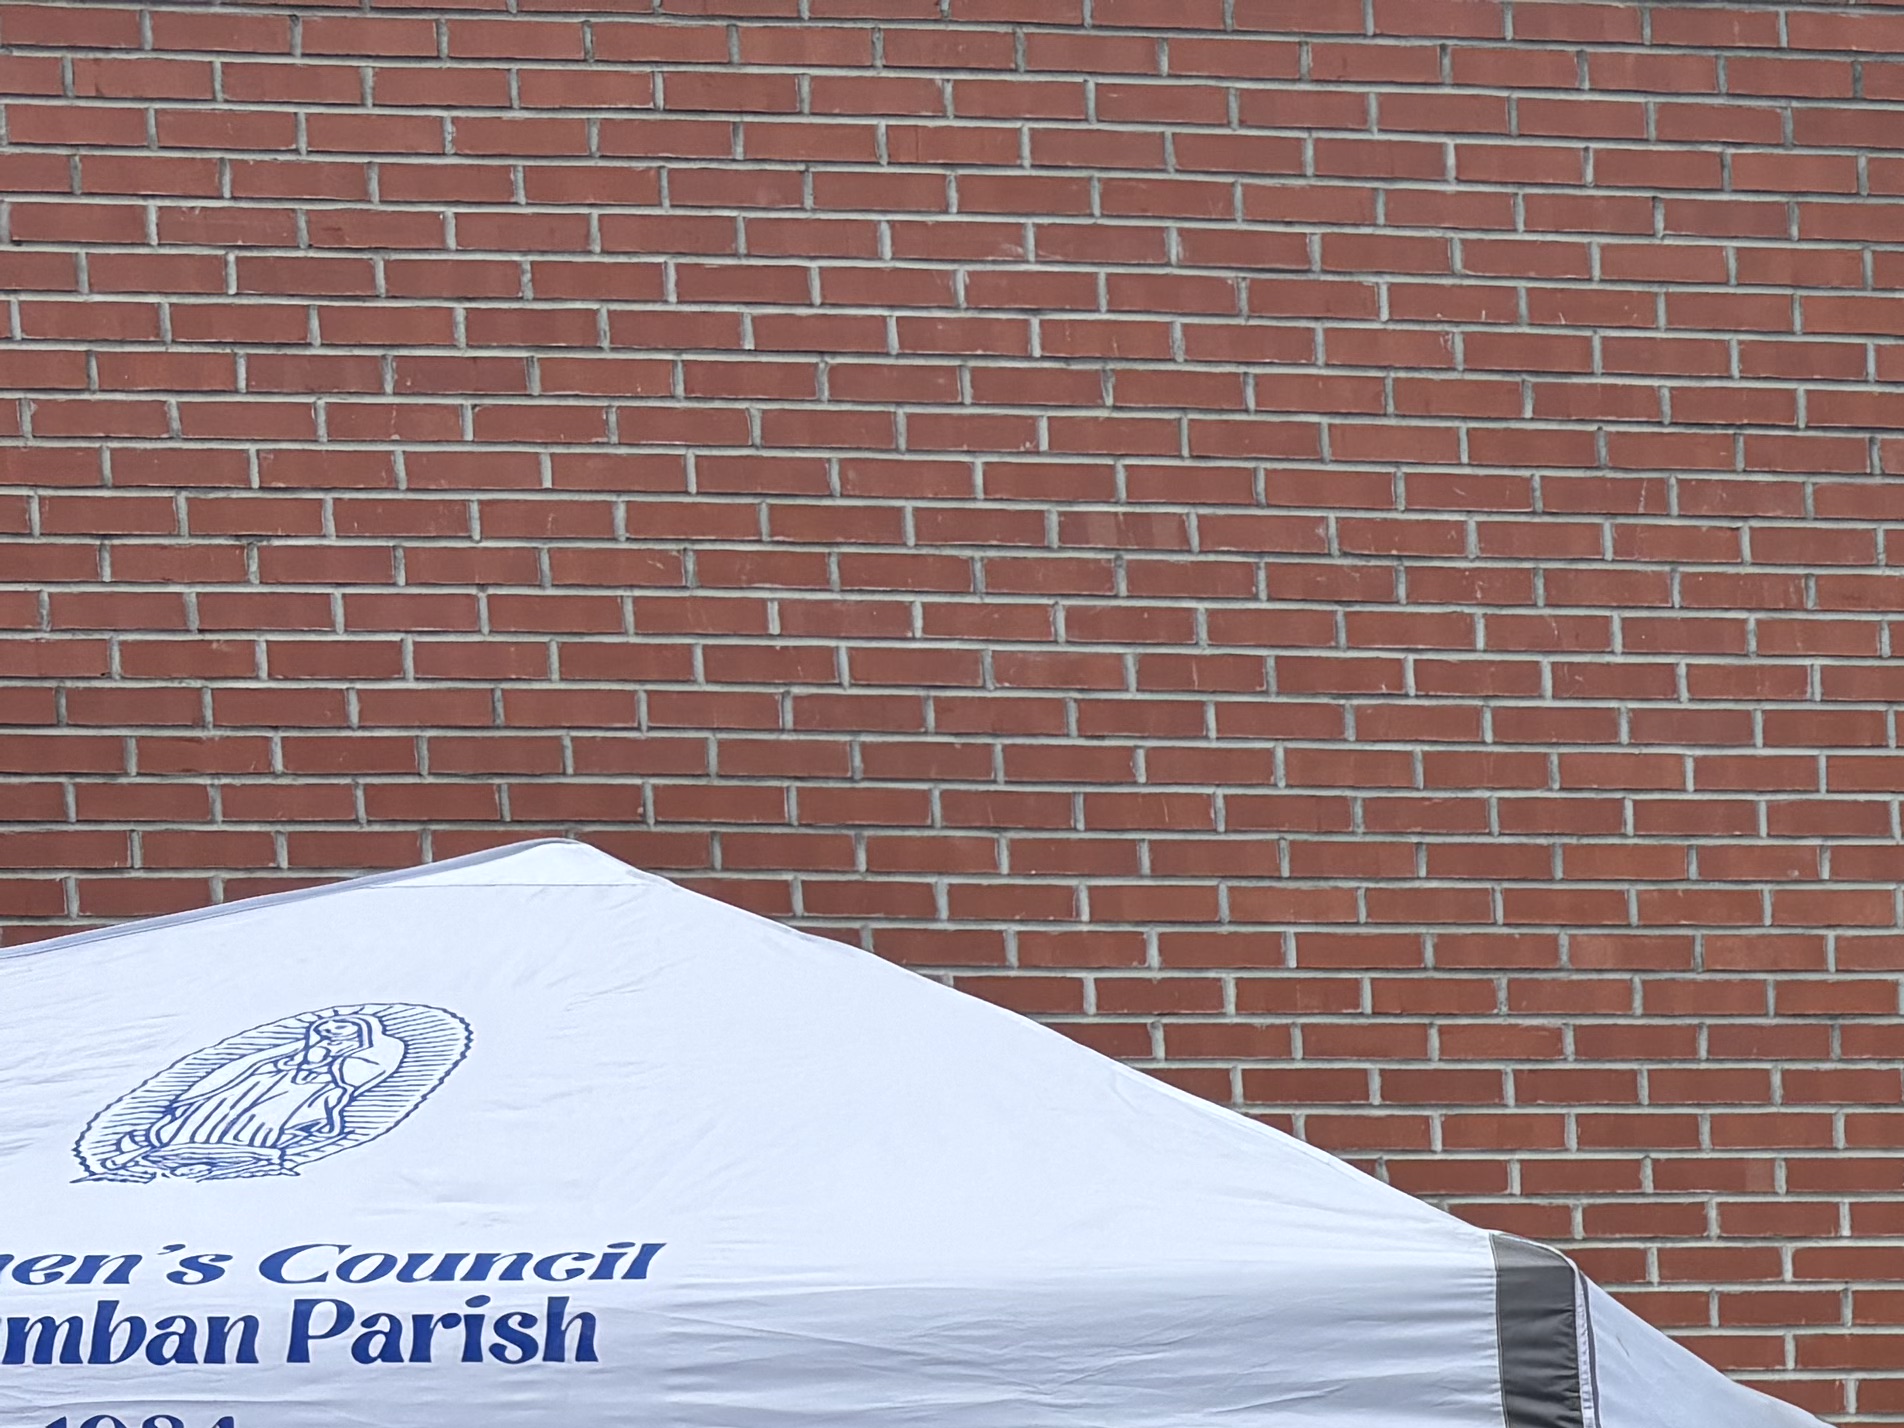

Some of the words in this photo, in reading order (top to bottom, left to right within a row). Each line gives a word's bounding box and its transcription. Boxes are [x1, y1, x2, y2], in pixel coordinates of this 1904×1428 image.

[258, 1241, 667, 1284] Council
[0, 1299, 260, 1365] mban
[286, 1294, 599, 1364] Parish
